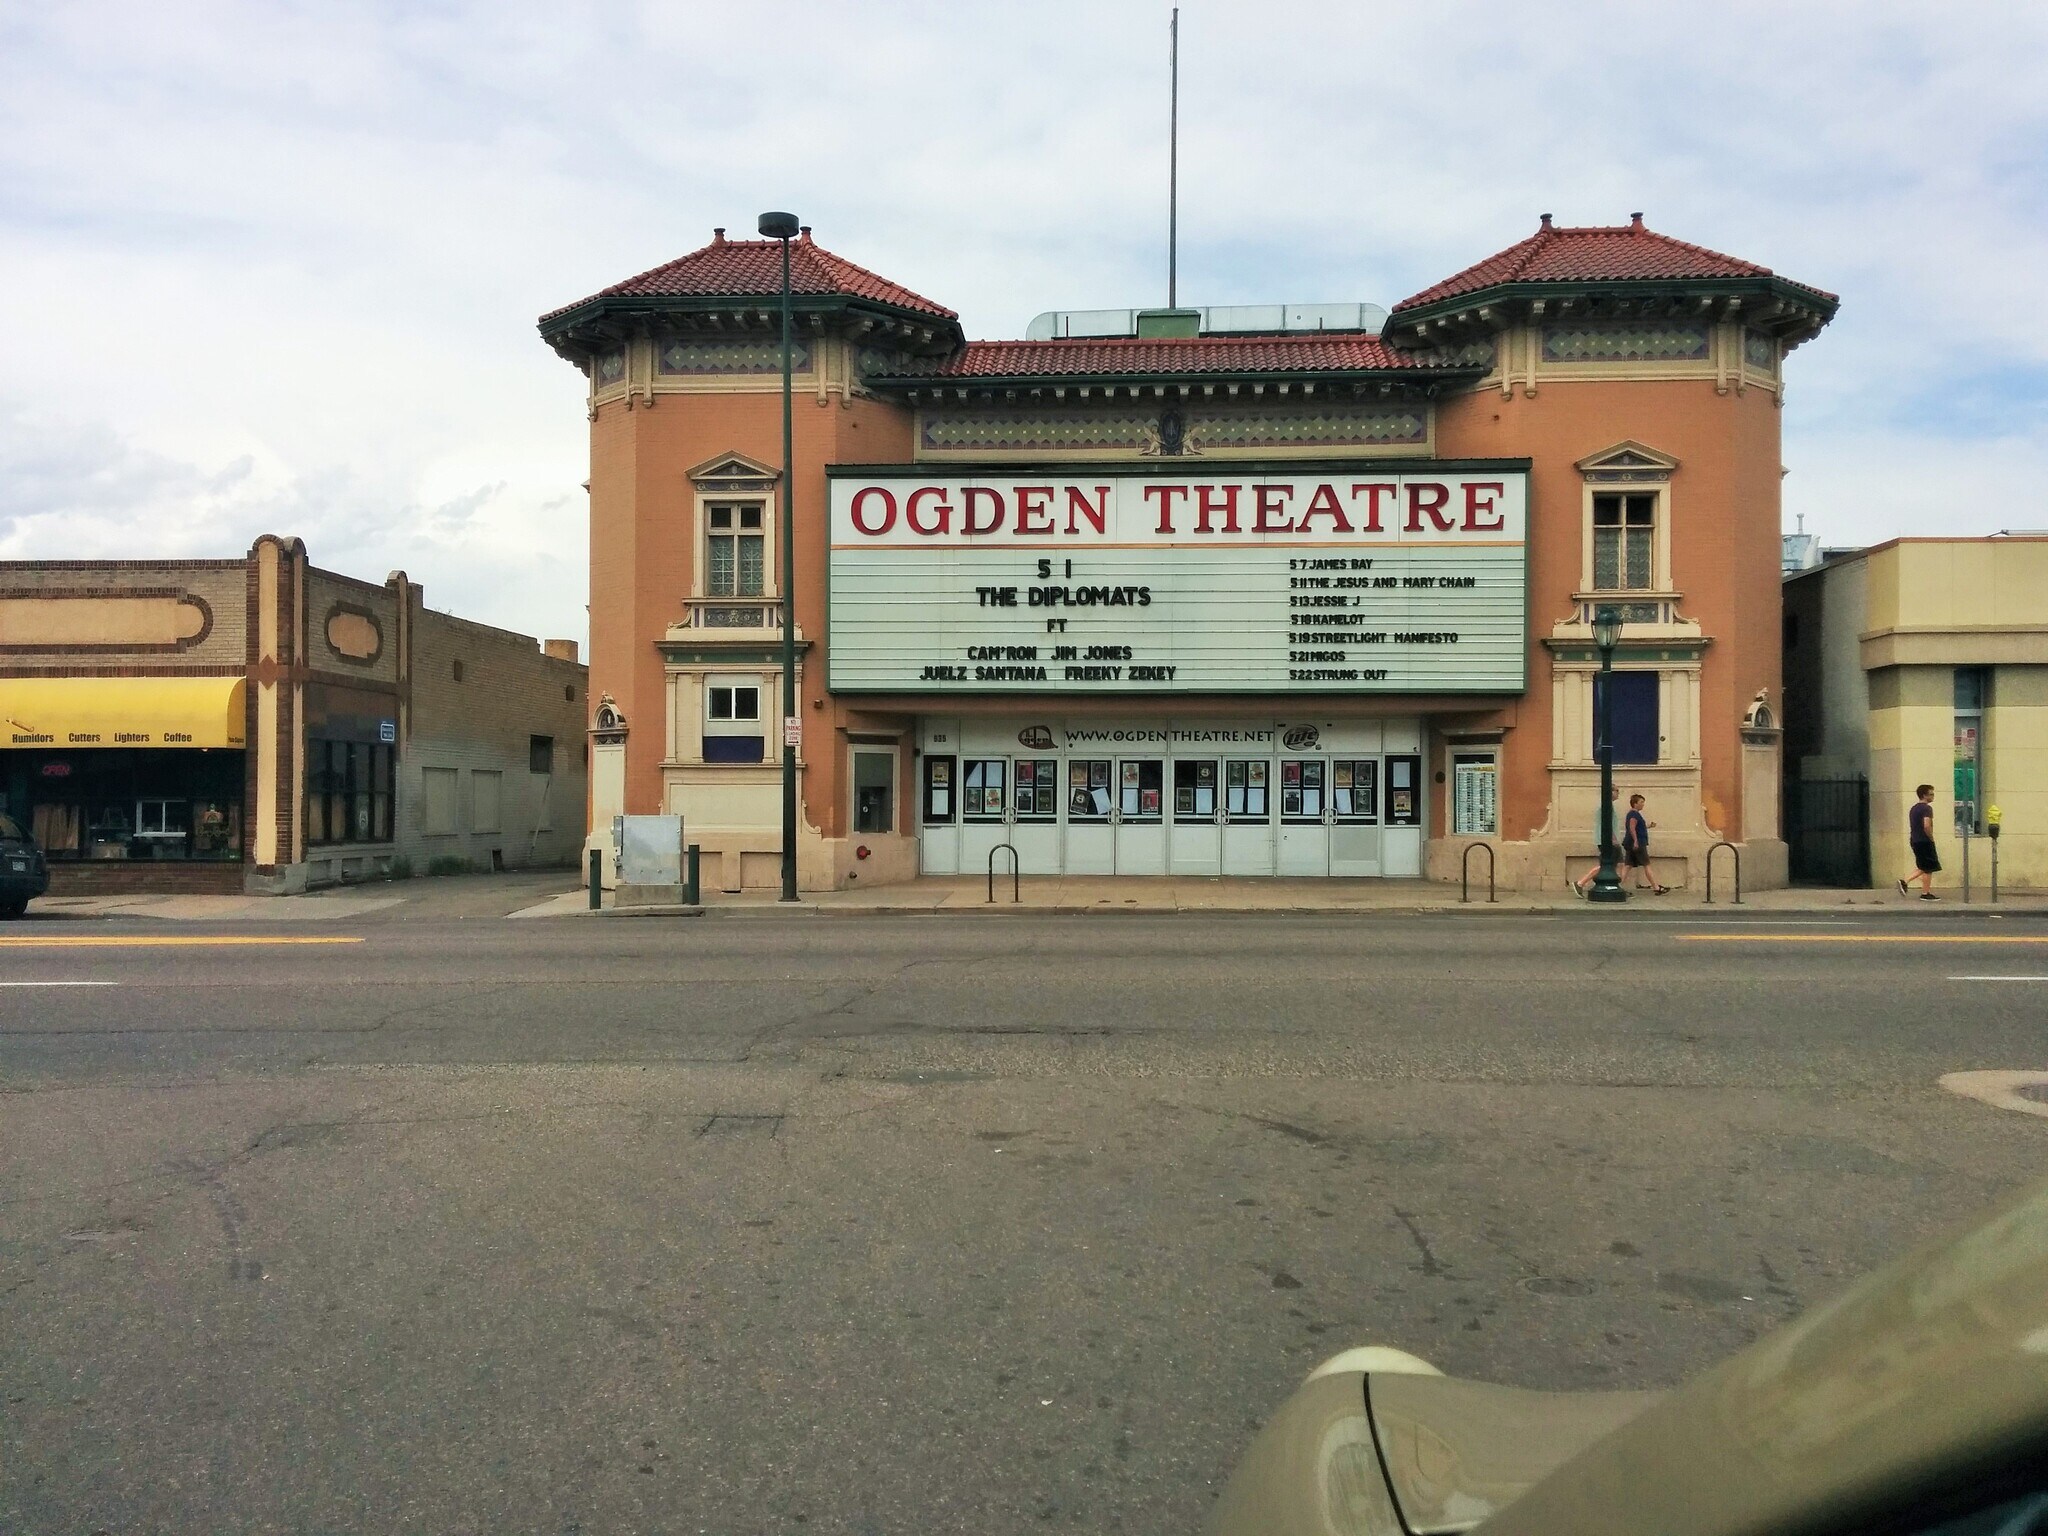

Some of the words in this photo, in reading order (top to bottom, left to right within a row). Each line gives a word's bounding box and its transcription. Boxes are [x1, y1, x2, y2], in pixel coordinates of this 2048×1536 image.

[850, 485, 1111, 535] OGDEN
[1144, 482, 1505, 534] THEATRE
[1037, 559, 1050, 579] 5
[1309, 559, 1347, 570] JAMES
[1351, 559, 1373, 570] BAY
[1333, 577, 1369, 588] JESUS
[1373, 577, 1397, 588] AND
[1403, 577, 1435, 588] MARY
[1439, 577, 1475, 588] CHAIN
[976, 587, 1017, 607] THE
[1029, 587, 1152, 607] DIPLOMATS
[1352, 596, 1360, 606] J
[1047, 619, 1067, 633] FT
[1311, 633, 1387, 643] STREETLIGHT
[1394, 633, 1458, 643] MANIFESTO
[967, 646, 1037, 660] CAM'RON
[1050, 646, 1077, 660] JIM
[1083, 646, 1132, 660] JONES
[919, 666, 967, 681] JUELZ
[975, 666, 1047, 681] SANTANA
[1065, 666, 1122, 681] FREEKY
[1128, 666, 1176, 681] ZEKEY
[1363, 669, 1388, 680] OUT
[12, 733, 54, 743] Humidors
[68, 732, 101, 742] Cutters
[114, 732, 150, 744] Lighters
[163, 732, 192, 742] Coffee
